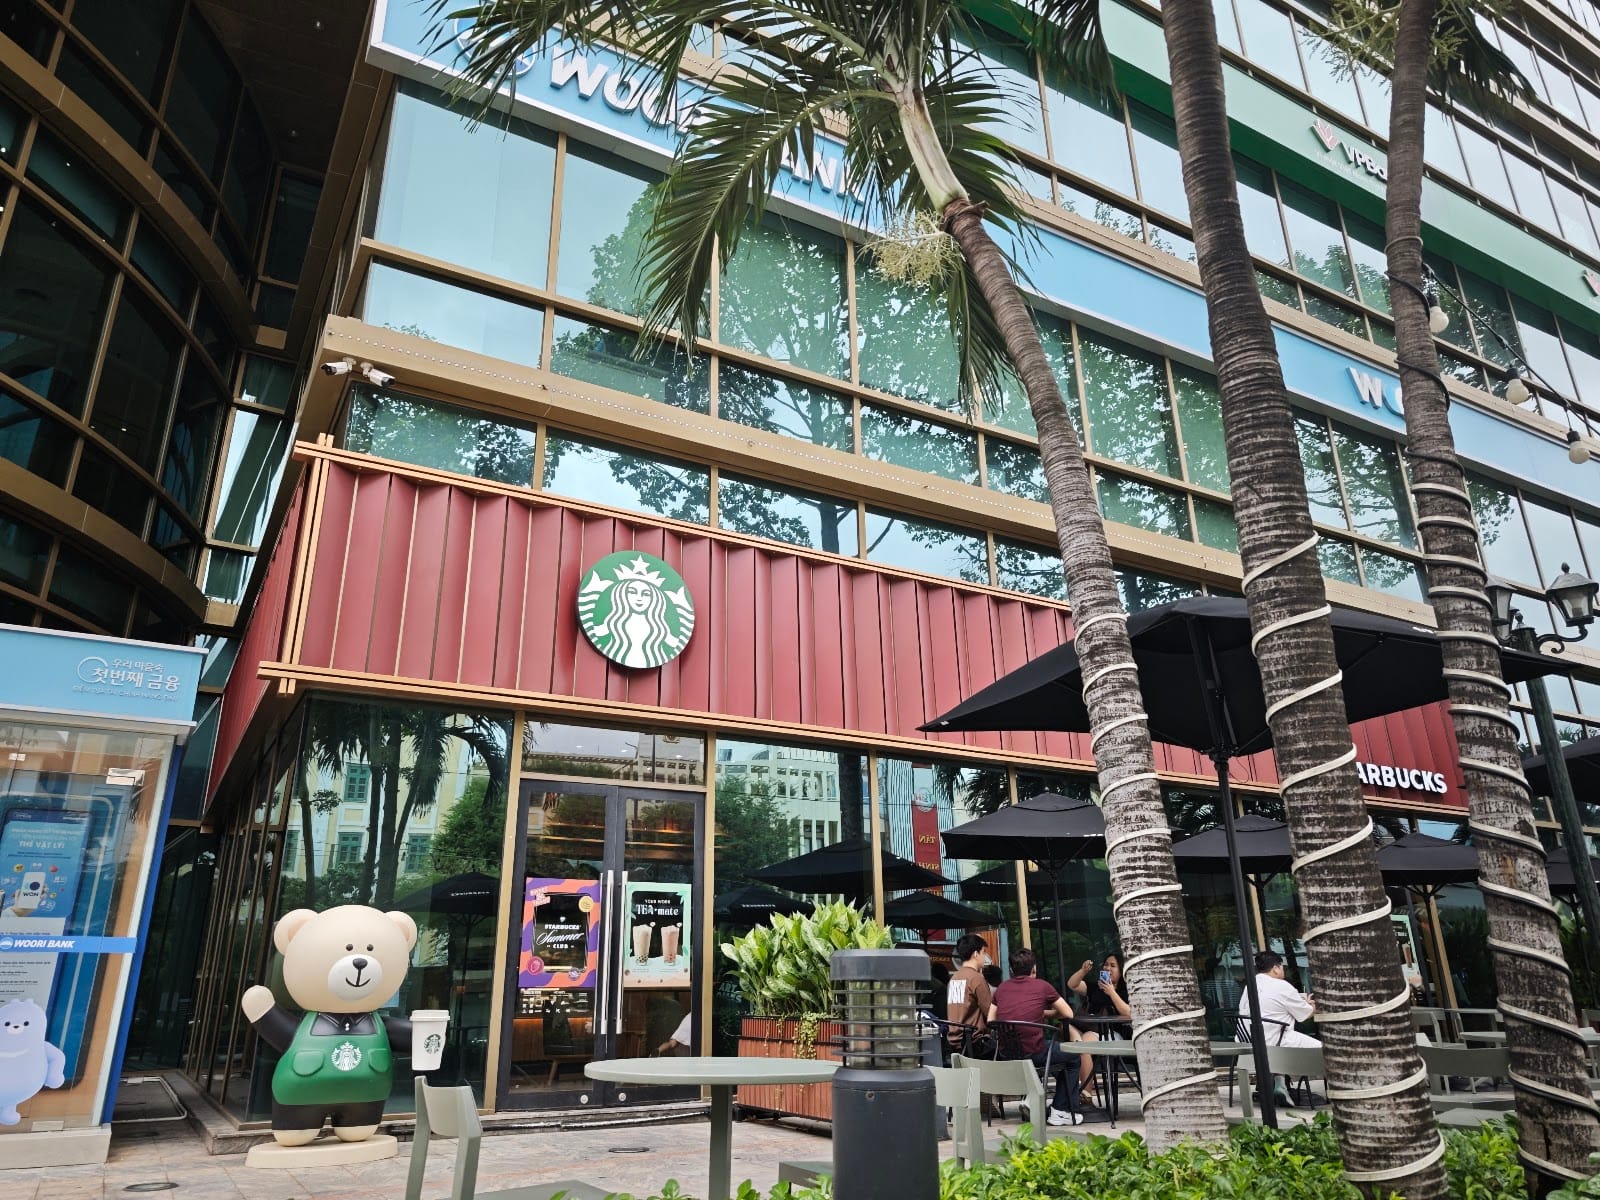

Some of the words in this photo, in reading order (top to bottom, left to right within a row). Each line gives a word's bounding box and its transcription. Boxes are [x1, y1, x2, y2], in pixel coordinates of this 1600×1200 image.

[91, 667, 144, 688] 첫번째
[148, 674, 180, 692] 금융
[1356, 762, 1447, 794] ARBUCKS
[14, 939, 47, 948] WOORI
[47, 940, 76, 948] BANK
[537, 930, 584, 945] Summer
